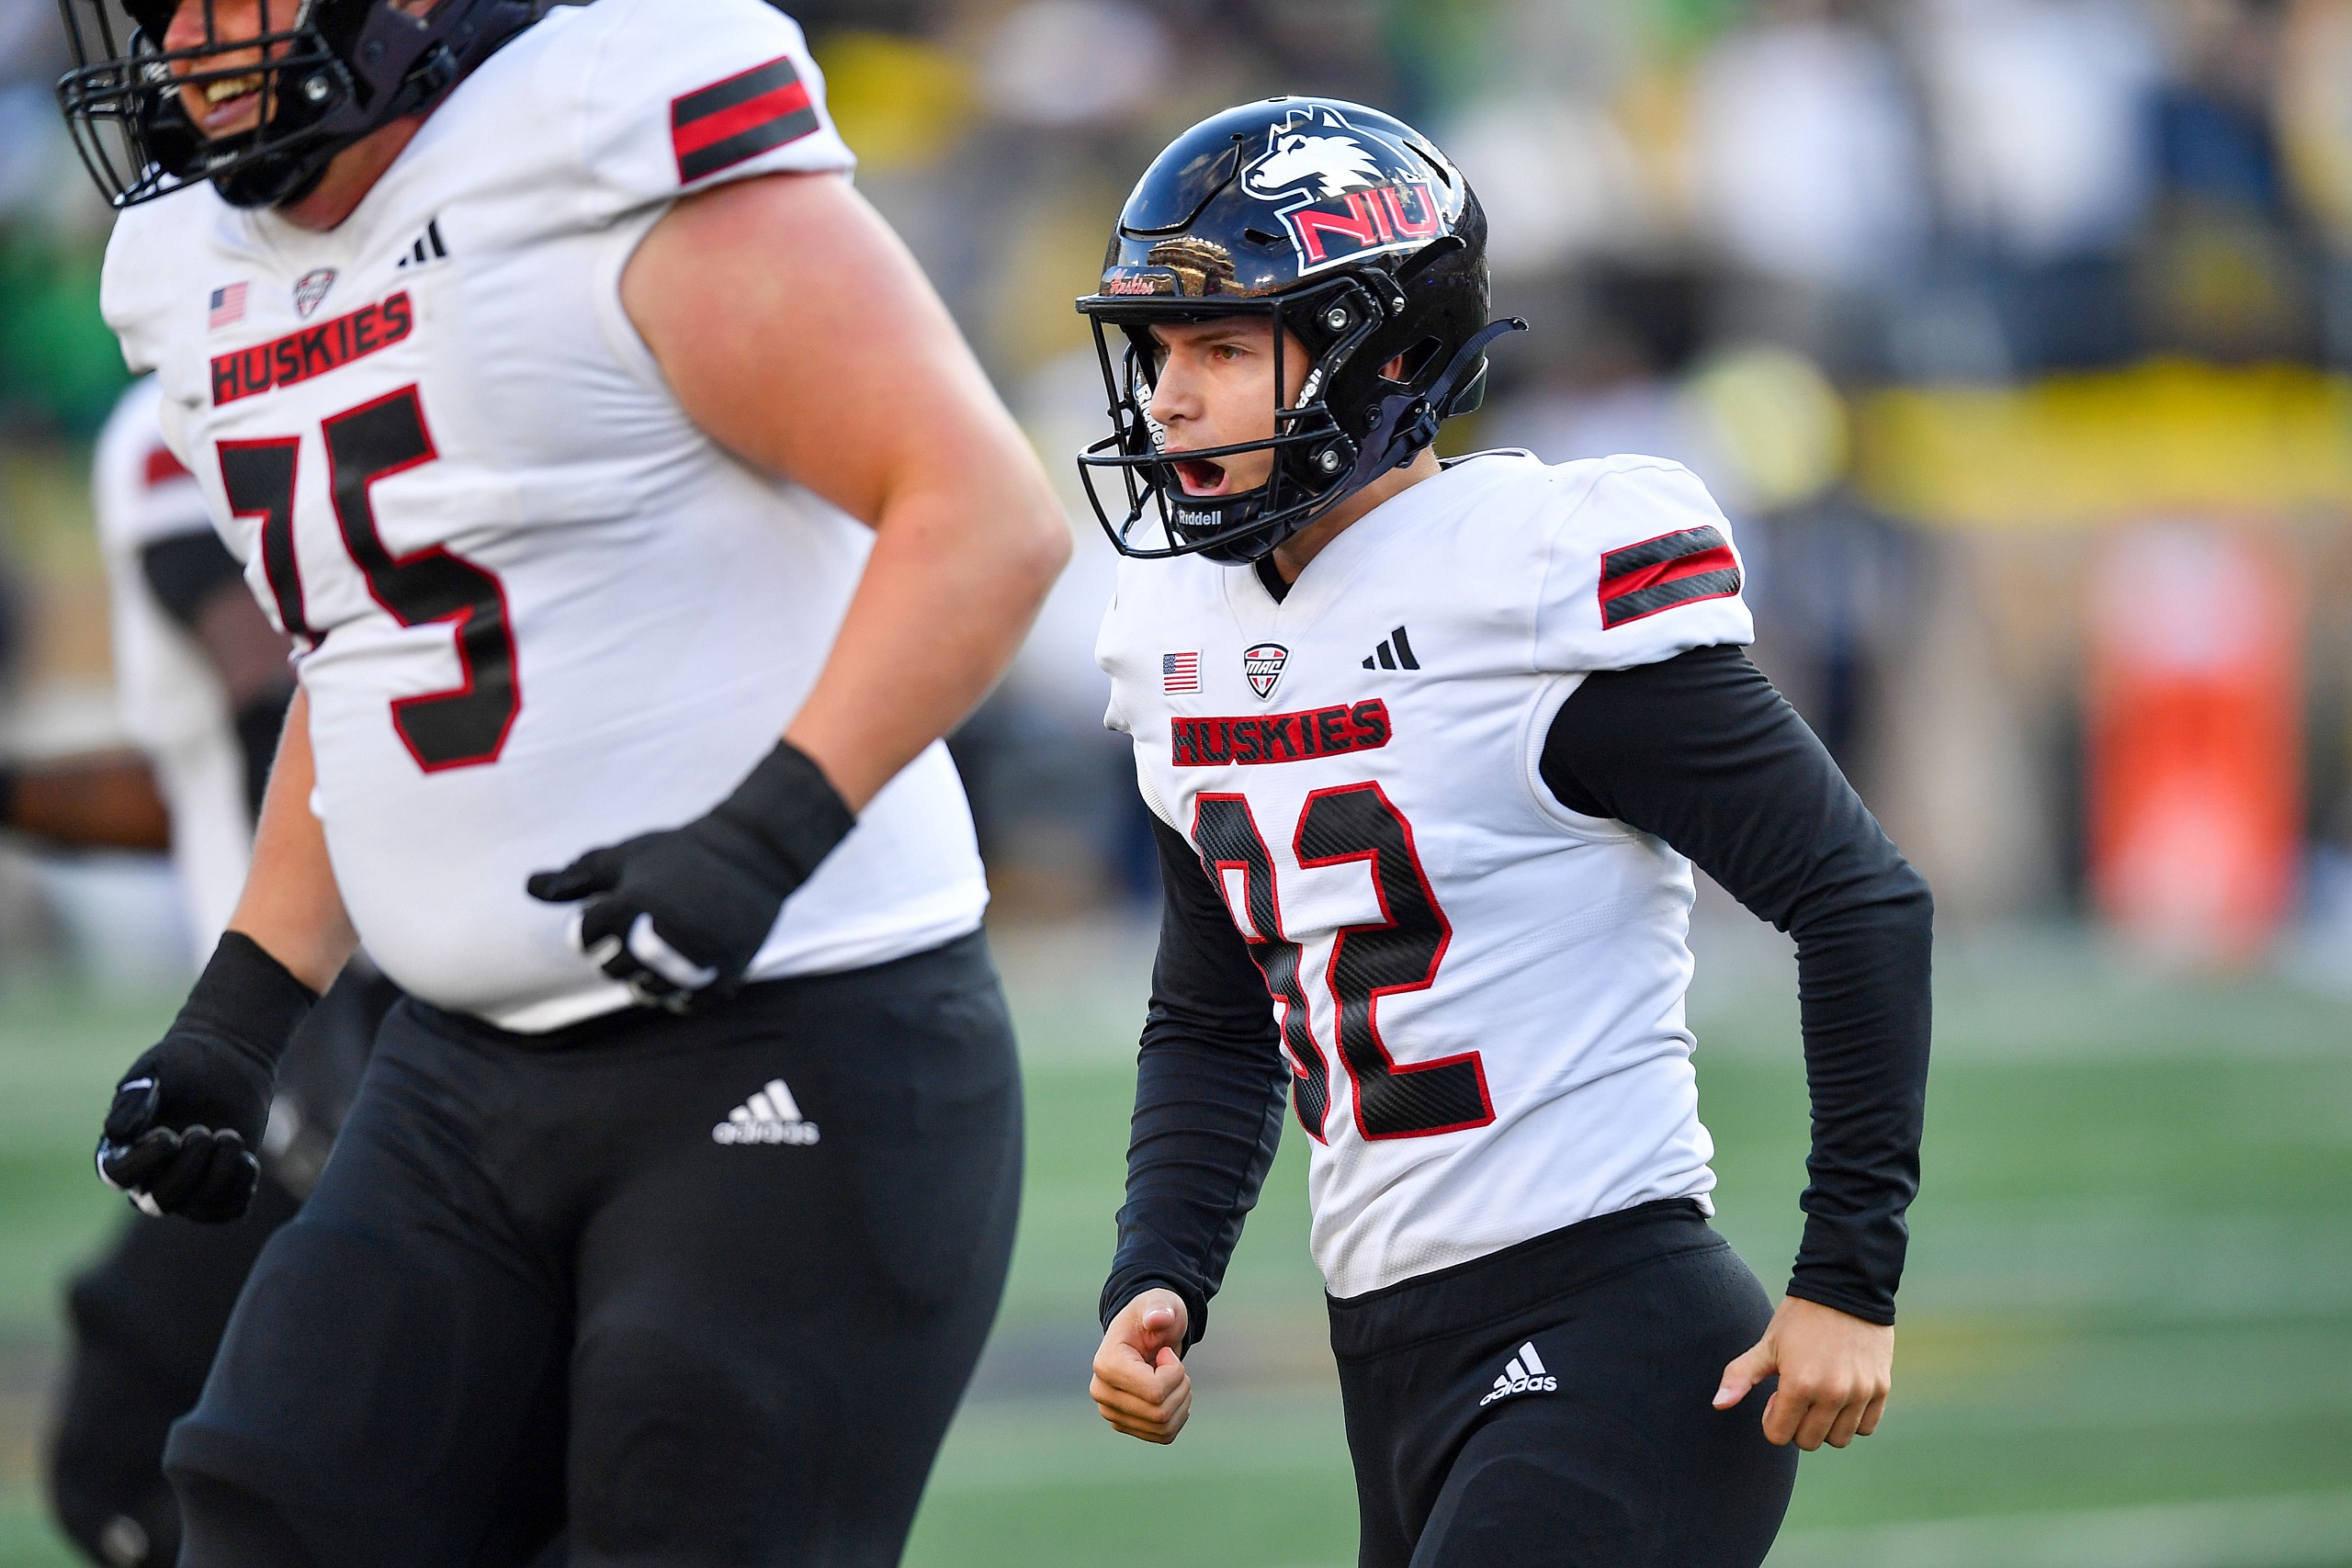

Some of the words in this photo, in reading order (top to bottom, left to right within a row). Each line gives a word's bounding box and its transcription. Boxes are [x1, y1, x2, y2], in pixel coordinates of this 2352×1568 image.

[1292, 186, 1440, 264] NIU
[212, 295, 411, 403] HUSKIES
[1179, 510, 1222, 525] Riddell
[215, 382, 523, 775] 75
[1246, 660, 1283, 674] MAC
[1172, 702, 1386, 763] HUSKIES
[712, 1120, 821, 1145] adidas
[1478, 1374, 1558, 1406] adidas
